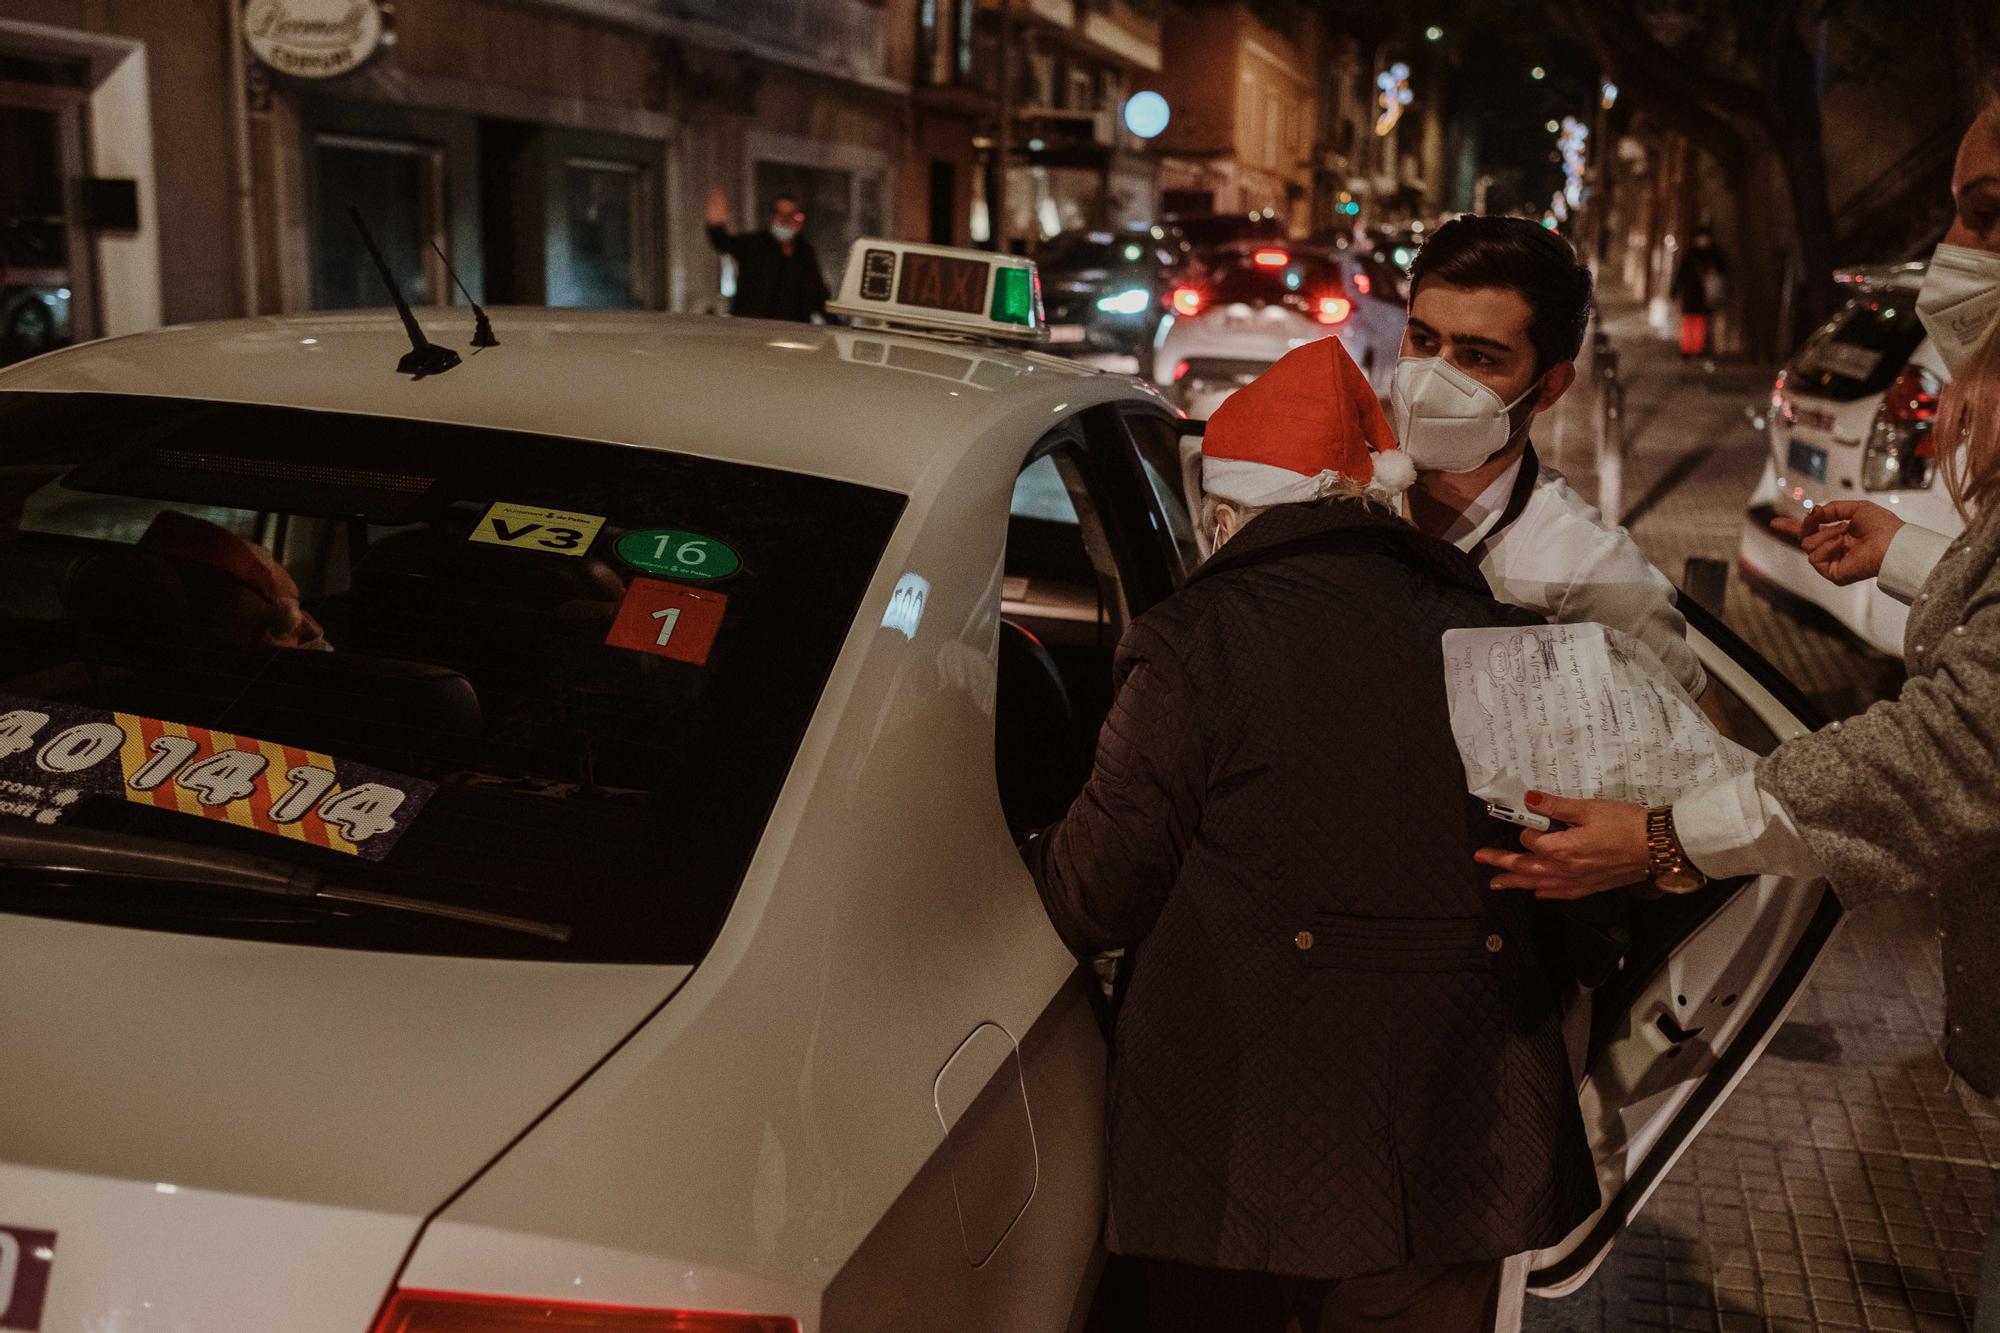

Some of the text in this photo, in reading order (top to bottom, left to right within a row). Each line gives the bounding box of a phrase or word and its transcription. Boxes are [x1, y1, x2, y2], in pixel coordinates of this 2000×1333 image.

[904, 257, 985, 310] TAXI
[491, 518, 583, 550] V3
[567, 516, 591, 525] Palma
[654, 534, 707, 566] 16
[651, 607, 681, 646] 1
